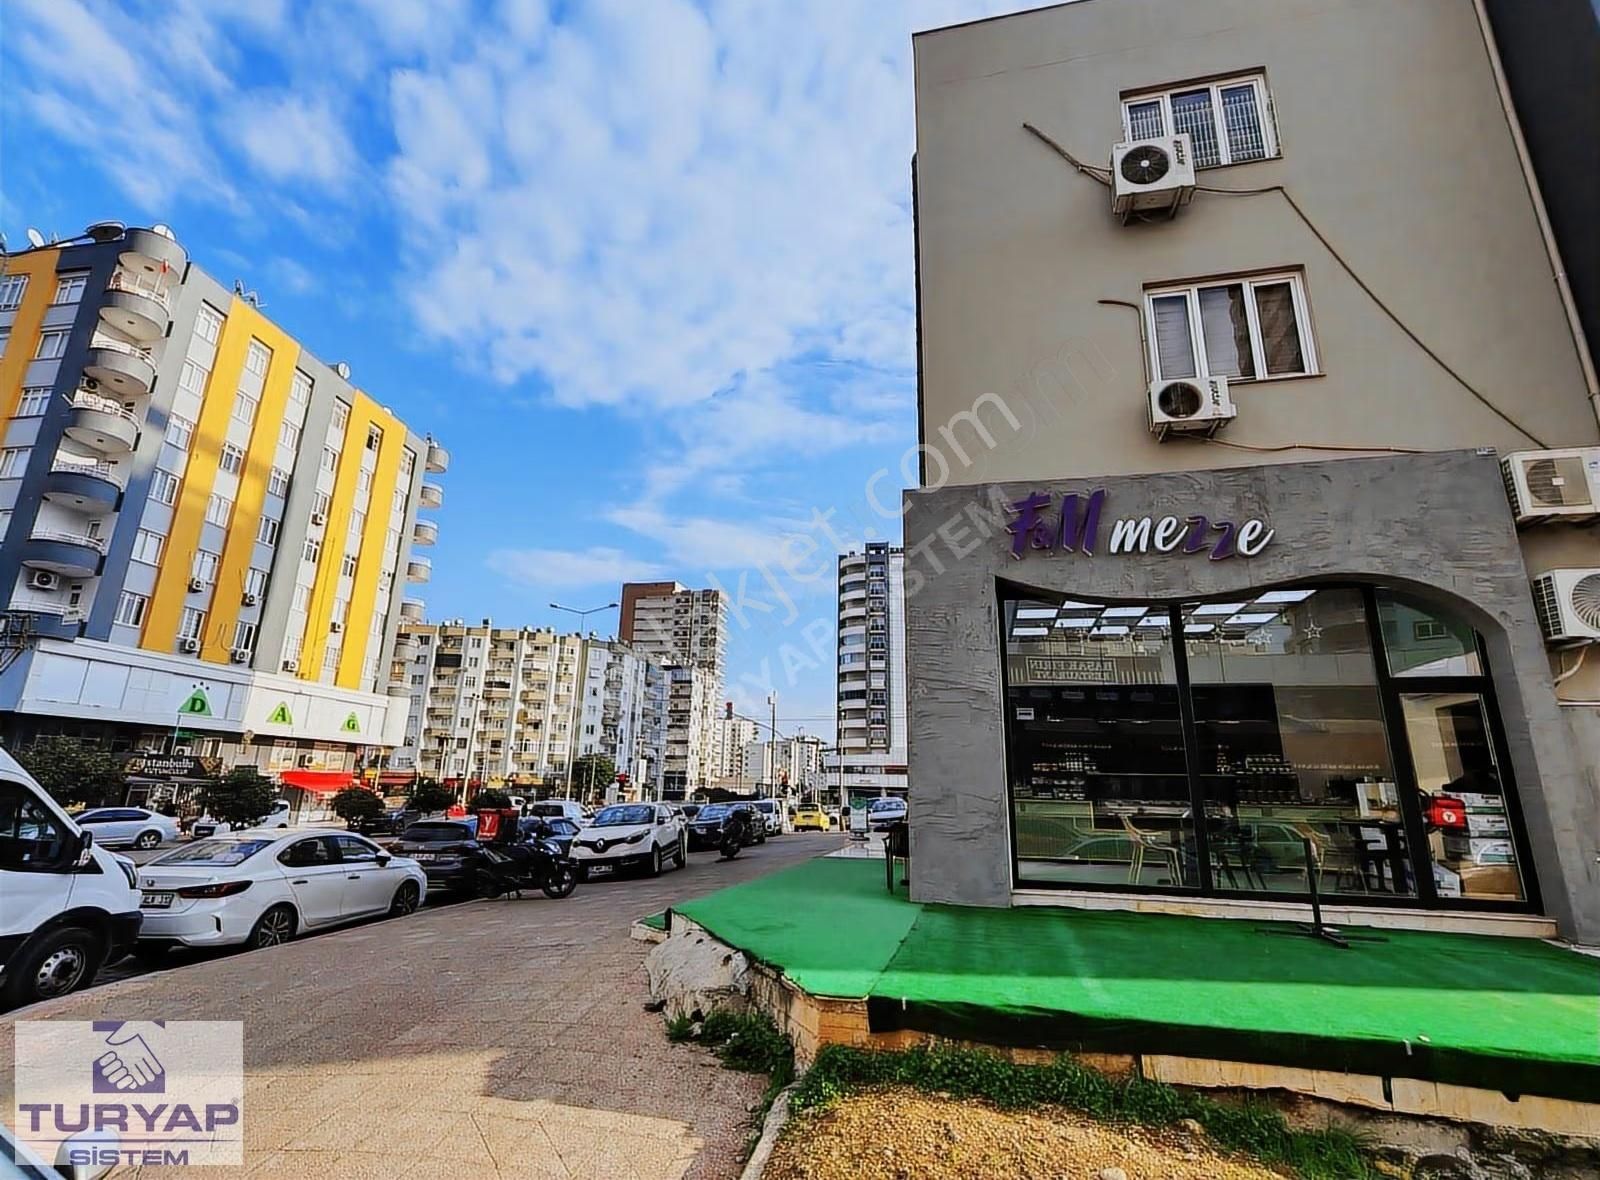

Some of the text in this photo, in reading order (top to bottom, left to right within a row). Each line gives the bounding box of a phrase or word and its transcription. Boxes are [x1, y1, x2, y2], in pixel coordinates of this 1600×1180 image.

[1110, 514, 1275, 562] mezze
[189, 697, 206, 713] D
[274, 706, 289, 723] A
